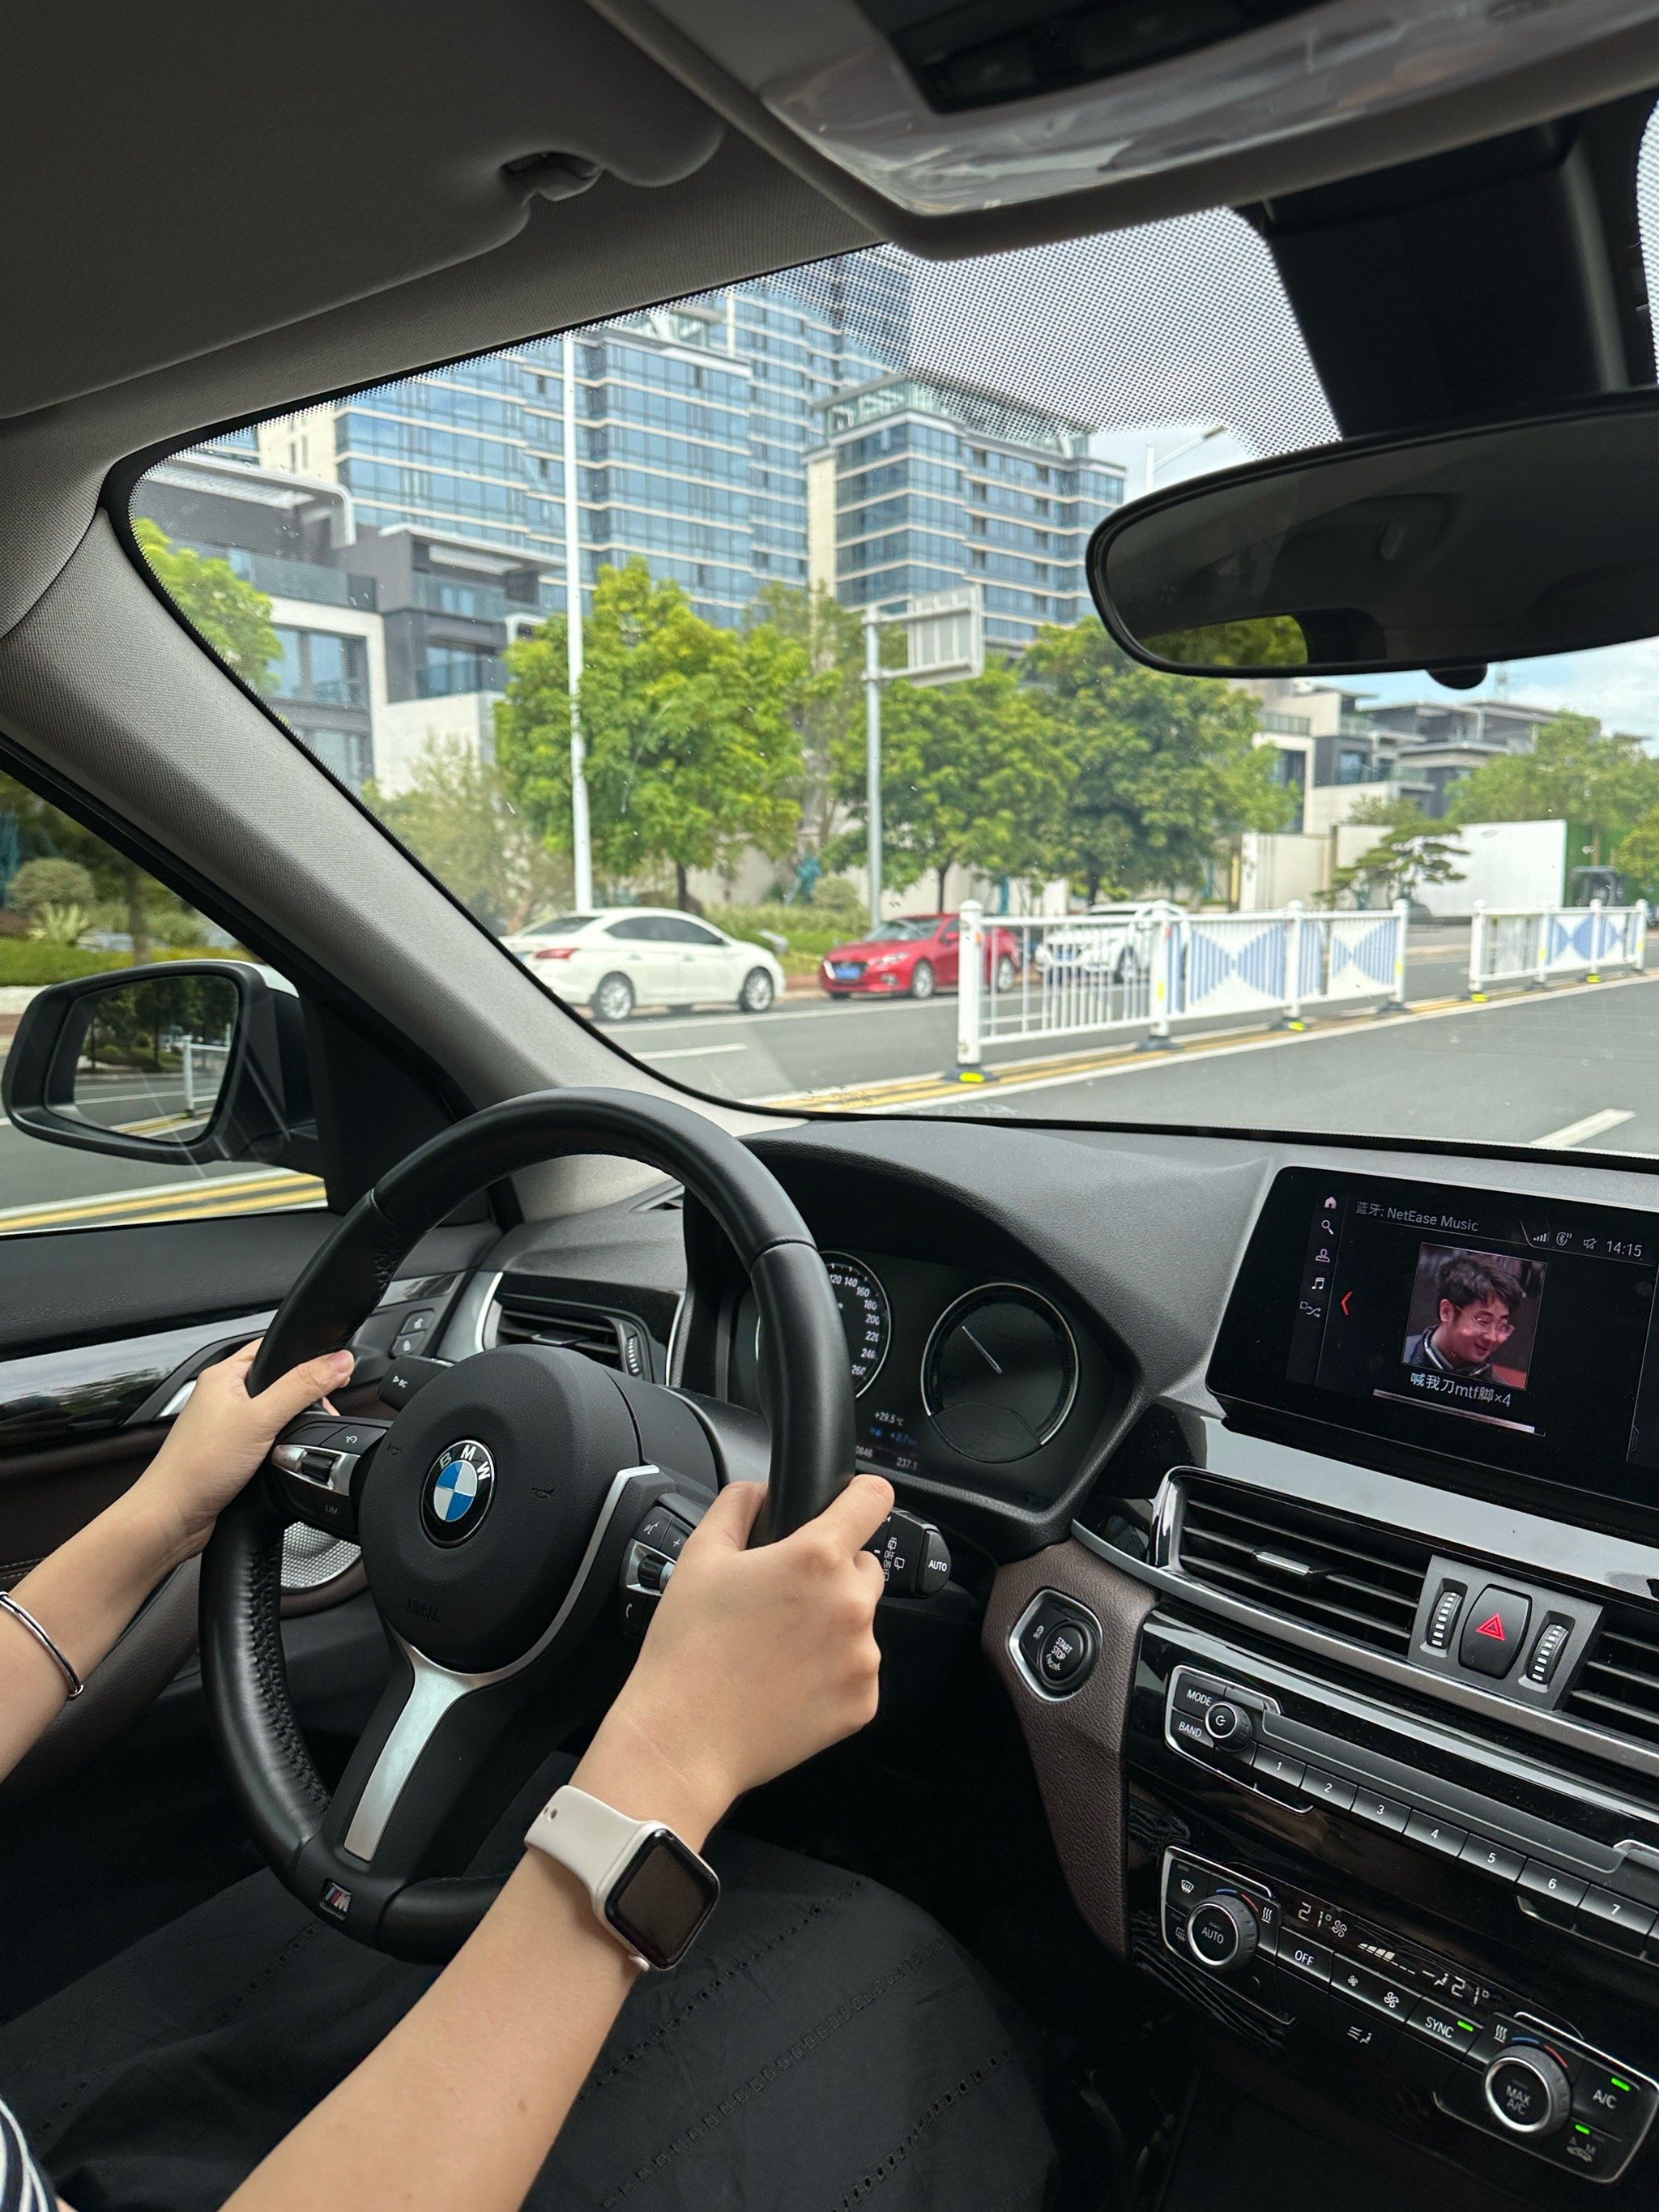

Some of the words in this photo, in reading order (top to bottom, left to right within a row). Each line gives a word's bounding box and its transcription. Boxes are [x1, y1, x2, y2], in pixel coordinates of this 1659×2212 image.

[1355, 1201, 1384, 1216] 蓝牙:
[1387, 1207, 1438, 1225] NetEase
[1440, 1215, 1479, 1232] Music
[1606, 1241, 1643, 1257] 14:15
[830, 1274, 842, 1285] 120
[844, 1276, 858, 1287] 140
[856, 1286, 870, 1297] 160
[864, 1299, 877, 1310] 180
[865, 1313, 880, 1326] 200
[851, 1364, 866, 1376] 260
[439, 1444, 491, 1481] BMW
[896, 1457, 918, 1471] 237.1
[928, 1559, 948, 1573] AUTO
[1051, 1645, 1066, 1660] STOP
[1055, 1636, 1073, 1655] START
[1186, 1689, 1213, 1706] MODE
[1178, 1721, 1202, 1737] BAND
[1276, 1761, 1282, 1771] 1
[1324, 1783, 1333, 1793] 2
[1376, 1804, 1385, 1815] 3
[1431, 1829, 1439, 1839] 4
[1487, 1852, 1496, 1864] 5
[1548, 1878, 1557, 1890] 6
[1611, 1903, 1621, 1915] 7
[1201, 1926, 1225, 1944] AUTO
[1294, 1949, 1315, 1966] OFF
[1425, 2016, 1455, 2039] SYNC
[1505, 2085, 1531, 2106] MAX
[1592, 2088, 1617, 2110] A/C
[1506, 2098, 1528, 2116] A/C
[1569, 2135, 1577, 2146] A
[1585, 2143, 1597, 2156] M
